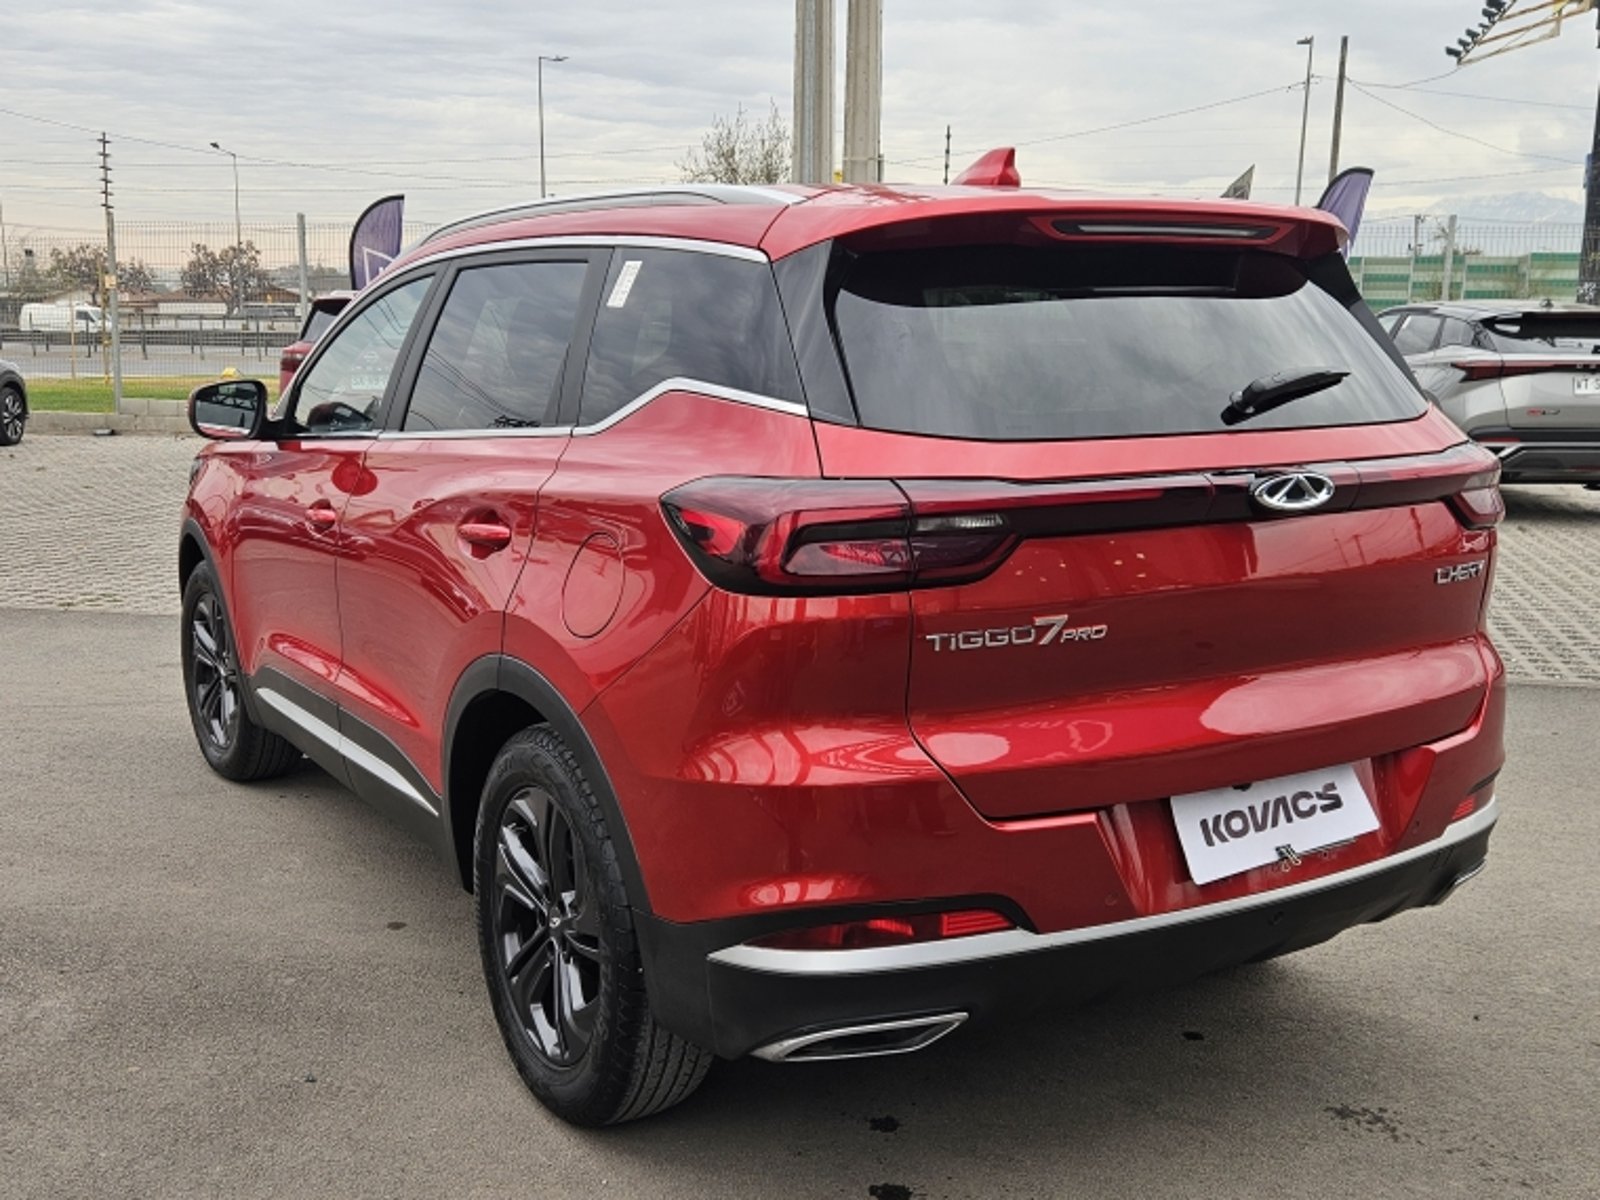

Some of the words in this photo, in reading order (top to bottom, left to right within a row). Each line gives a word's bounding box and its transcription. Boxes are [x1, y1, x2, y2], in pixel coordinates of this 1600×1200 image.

[1034, 614, 1068, 645] 7
[1060, 625, 1108, 643] PRO
[1199, 781, 1344, 847] KOVACS
